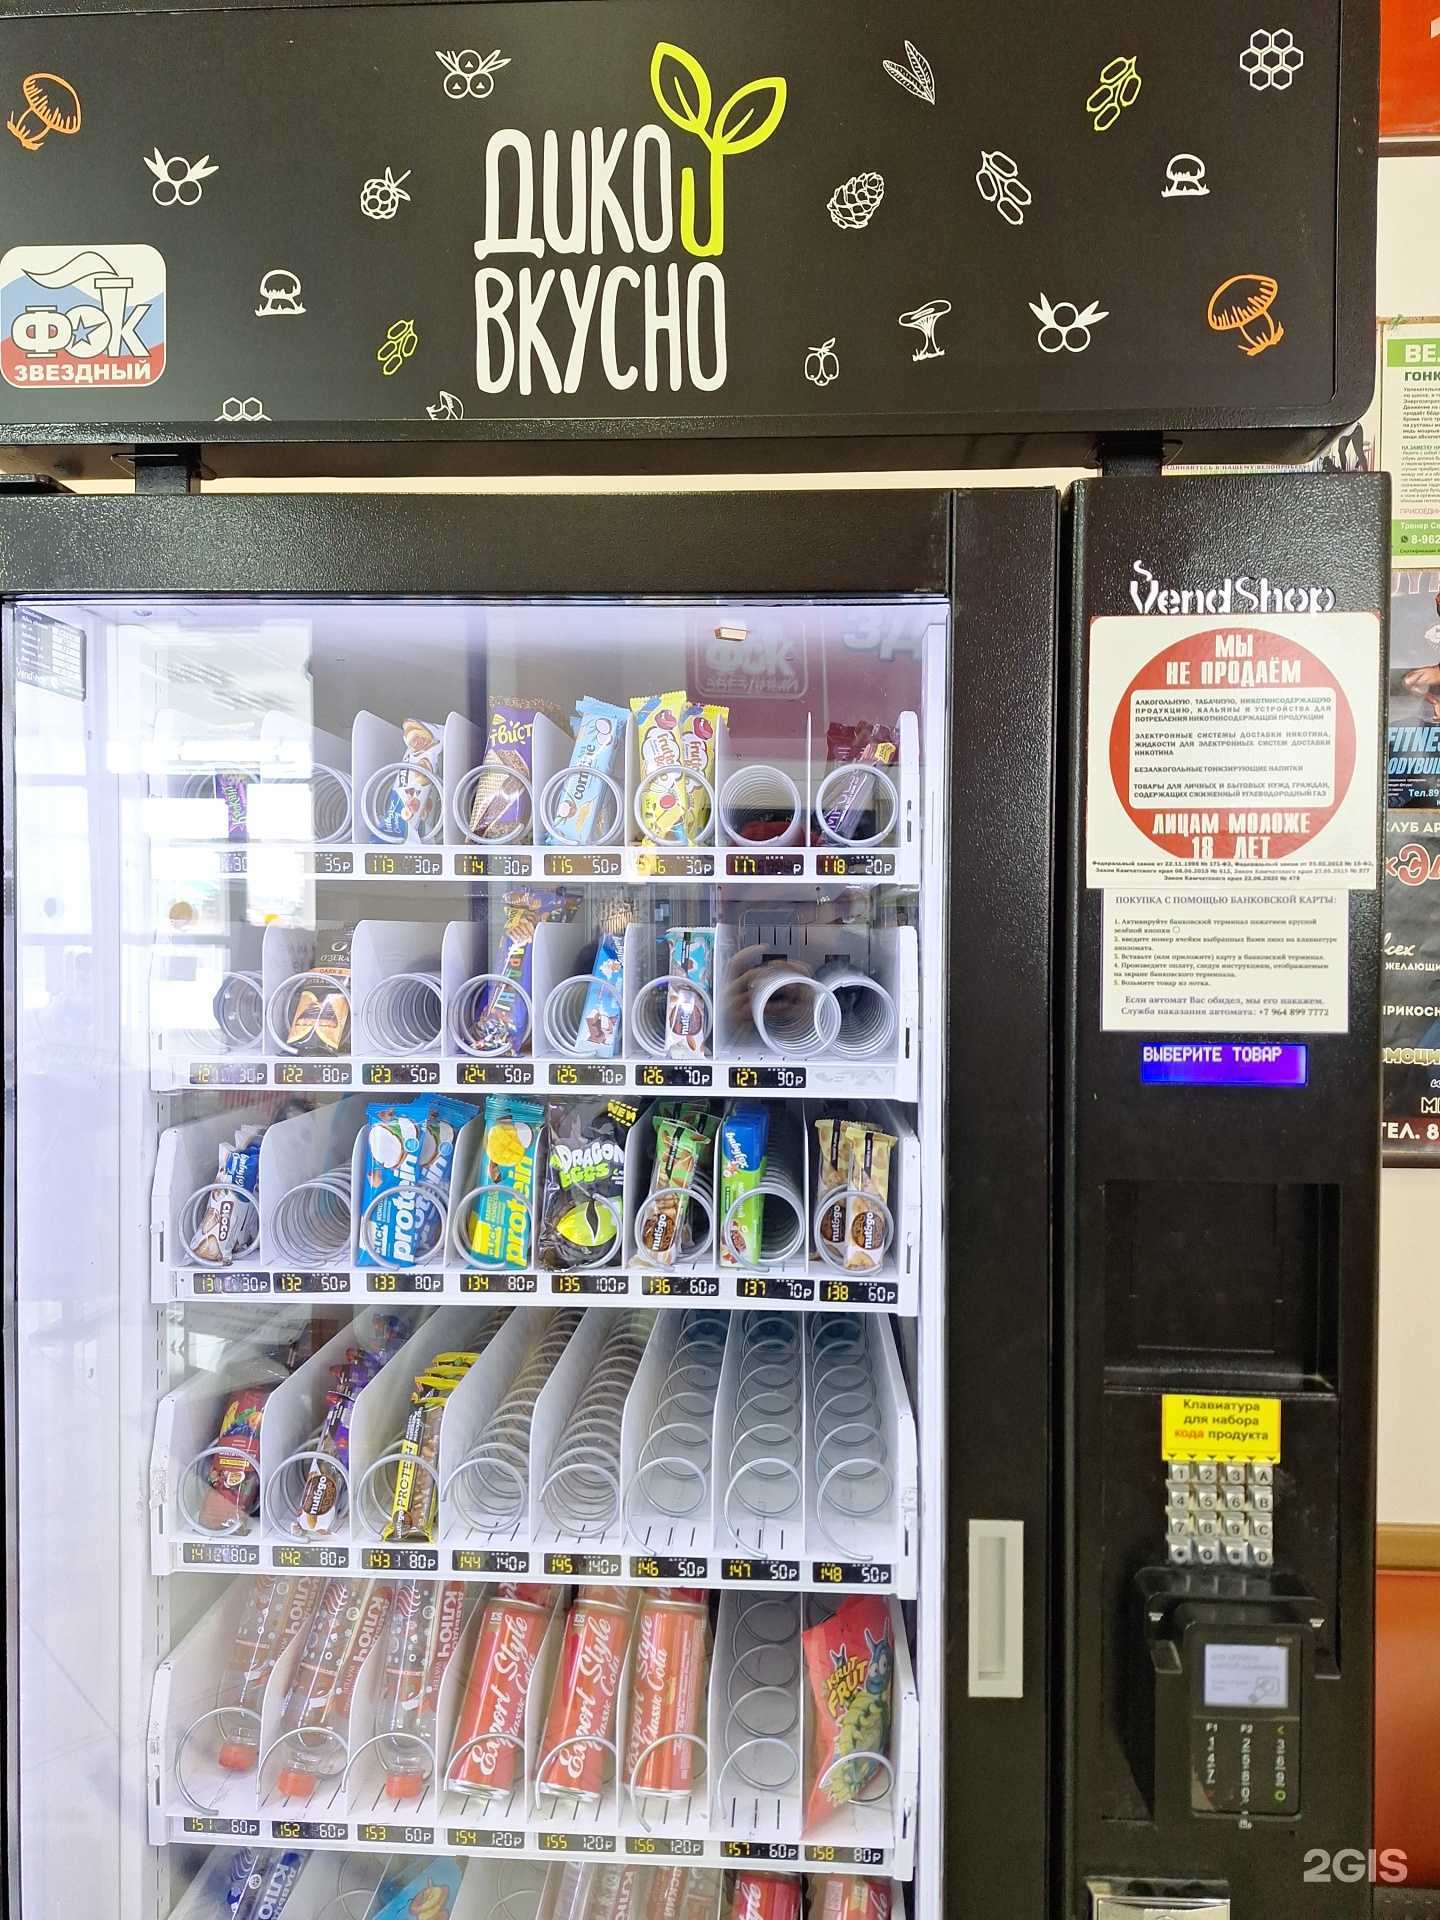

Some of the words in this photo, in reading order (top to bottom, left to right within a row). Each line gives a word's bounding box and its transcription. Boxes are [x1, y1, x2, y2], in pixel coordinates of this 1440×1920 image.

[11, 300, 153, 359] ФОК
[474, 261, 727, 395] ВКУСНО
[14, 360, 151, 384] ЗВЕЗДНЫЙ
[1130, 574, 1336, 614] VendShop
[1215, 635, 1253, 657] МЫ
[1166, 661, 1190, 685] НЕ
[1201, 657, 1301, 687] ПРОДАЁМ
[1255, 705, 1310, 713] УСТРОЙСТВА
[1388, 727, 1440, 752] FITNE
[1134, 791, 1187, 799] СОДЕРЖАЩИХ
[1313, 789, 1326, 797] ГАЗ
[1152, 813, 1219, 837] ЛИЦАМ
[1228, 813, 1310, 833] МОЛОЖЕ
[1191, 836, 1214, 859] 18
[1233, 836, 1271, 859] ЛЕТ
[372, 859, 394, 872] 113
[463, 860, 484, 873] 114
[552, 859, 573, 873] 115
[735, 860, 756, 873] 117
[825, 859, 845, 873] 118
[1115, 896, 1163, 904] ПОКУПКА
[1165, 896, 1171, 904] С
[1173, 896, 1228, 905] ПОМОЩЬЮ
[1230, 894, 1297, 904] БАНКОВСКОЙ
[1299, 895, 1336, 904] КАРТЫ:
[1126, 996, 1147, 1004] Если
[1189, 996, 1206, 1004] Вас
[1208, 996, 1243, 1005] обидел,
[1121, 1007, 1155, 1016] Служба
[1259, 1008, 1268, 1016] +7
[1271, 1008, 1288, 1016] 964
[1290, 1008, 1306, 1016] 899
[1308, 1008, 1329, 1016] 7772
[1143, 1047, 1222, 1063] ВЫБЕРИТЕ
[1232, 1047, 1282, 1063] ТОВАР
[283, 1068, 303, 1081] 122
[370, 1068, 391, 1082] 123
[465, 1068, 486, 1082] 124
[557, 1068, 578, 1082] 125
[643, 1070, 664, 1084] 126
[736, 1072, 758, 1085] 127
[553, 1142, 624, 1173] DRAGON
[559, 1162, 610, 1191] EGGS
[652, 1213, 667, 1251] nut&go
[863, 1211, 873, 1249] nut&go
[282, 1277, 302, 1290] 132
[375, 1277, 396, 1289] 133
[468, 1277, 489, 1290] 134
[560, 1278, 581, 1291] 135
[649, 1280, 671, 1293] 136
[745, 1281, 766, 1295] 137
[827, 1285, 848, 1300] 138
[1183, 1399, 1260, 1413] Клавиатура
[1184, 1414, 1208, 1424] для
[1212, 1413, 1259, 1427] набора
[1174, 1429, 1204, 1439] кода
[1208, 1430, 1268, 1441] продукта
[1204, 1470, 1212, 1481] 2
[1232, 1471, 1240, 1481] 3
[1260, 1471, 1268, 1481] A
[310, 1475, 327, 1517] nut&go
[280, 1550, 301, 1565] 142
[370, 1553, 391, 1568] 143
[459, 1554, 480, 1568] 144
[552, 1557, 573, 1573] 145
[638, 1561, 659, 1576] 146
[730, 1563, 751, 1577] 147
[820, 1567, 842, 1581] 148
[646, 1648, 668, 1692] Cola
[828, 1660, 868, 1718] FRUT
[280, 1824, 300, 1837] 152
[365, 1827, 386, 1840] 153
[454, 1830, 476, 1844] 154
[545, 1835, 567, 1848] 155
[632, 1839, 655, 1852] 156
[728, 1842, 750, 1855] 157
[811, 1846, 834, 1860] 158
